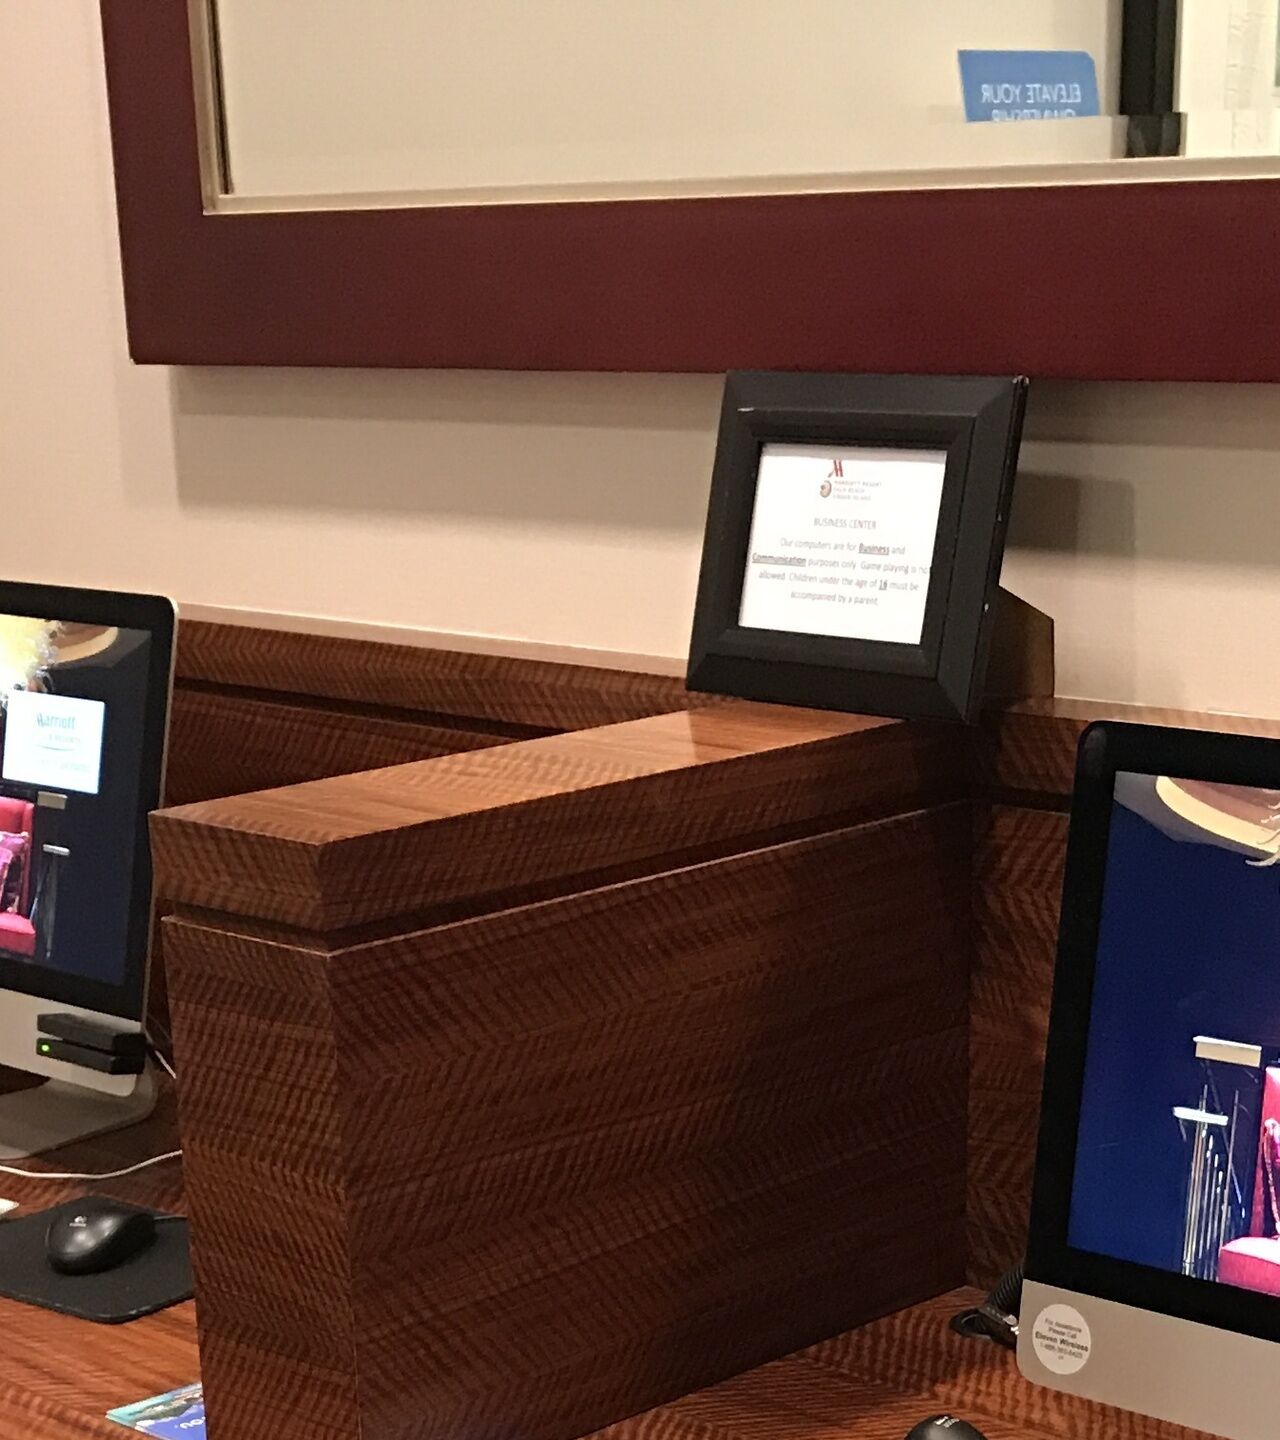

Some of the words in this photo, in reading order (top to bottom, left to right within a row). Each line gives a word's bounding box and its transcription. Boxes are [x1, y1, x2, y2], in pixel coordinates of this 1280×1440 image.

[813, 517, 847, 528] BUSINESS
[848, 519, 877, 530] CENTER
[794, 540, 831, 550] computers
[833, 543, 845, 551] are
[846, 541, 857, 551] for
[858, 542, 890, 555] Business
[891, 545, 906, 555] and
[751, 552, 807, 567] Communication
[808, 558, 839, 568] purposes
[860, 560, 881, 570] Game
[883, 563, 909, 575] playing
[788, 572, 817, 583] Children
[819, 575, 840, 585] under
[841, 577, 854, 585] the
[855, 578, 868, 589] age
[869, 579, 878, 588] of
[889, 582, 908, 591] must
[910, 582, 920, 591] be
[837, 594, 846, 604] by
[35, 711, 76, 731] Marriott
[1035, 1331, 1057, 1343] Eleven
[1060, 1338, 1088, 1352] Wireless
